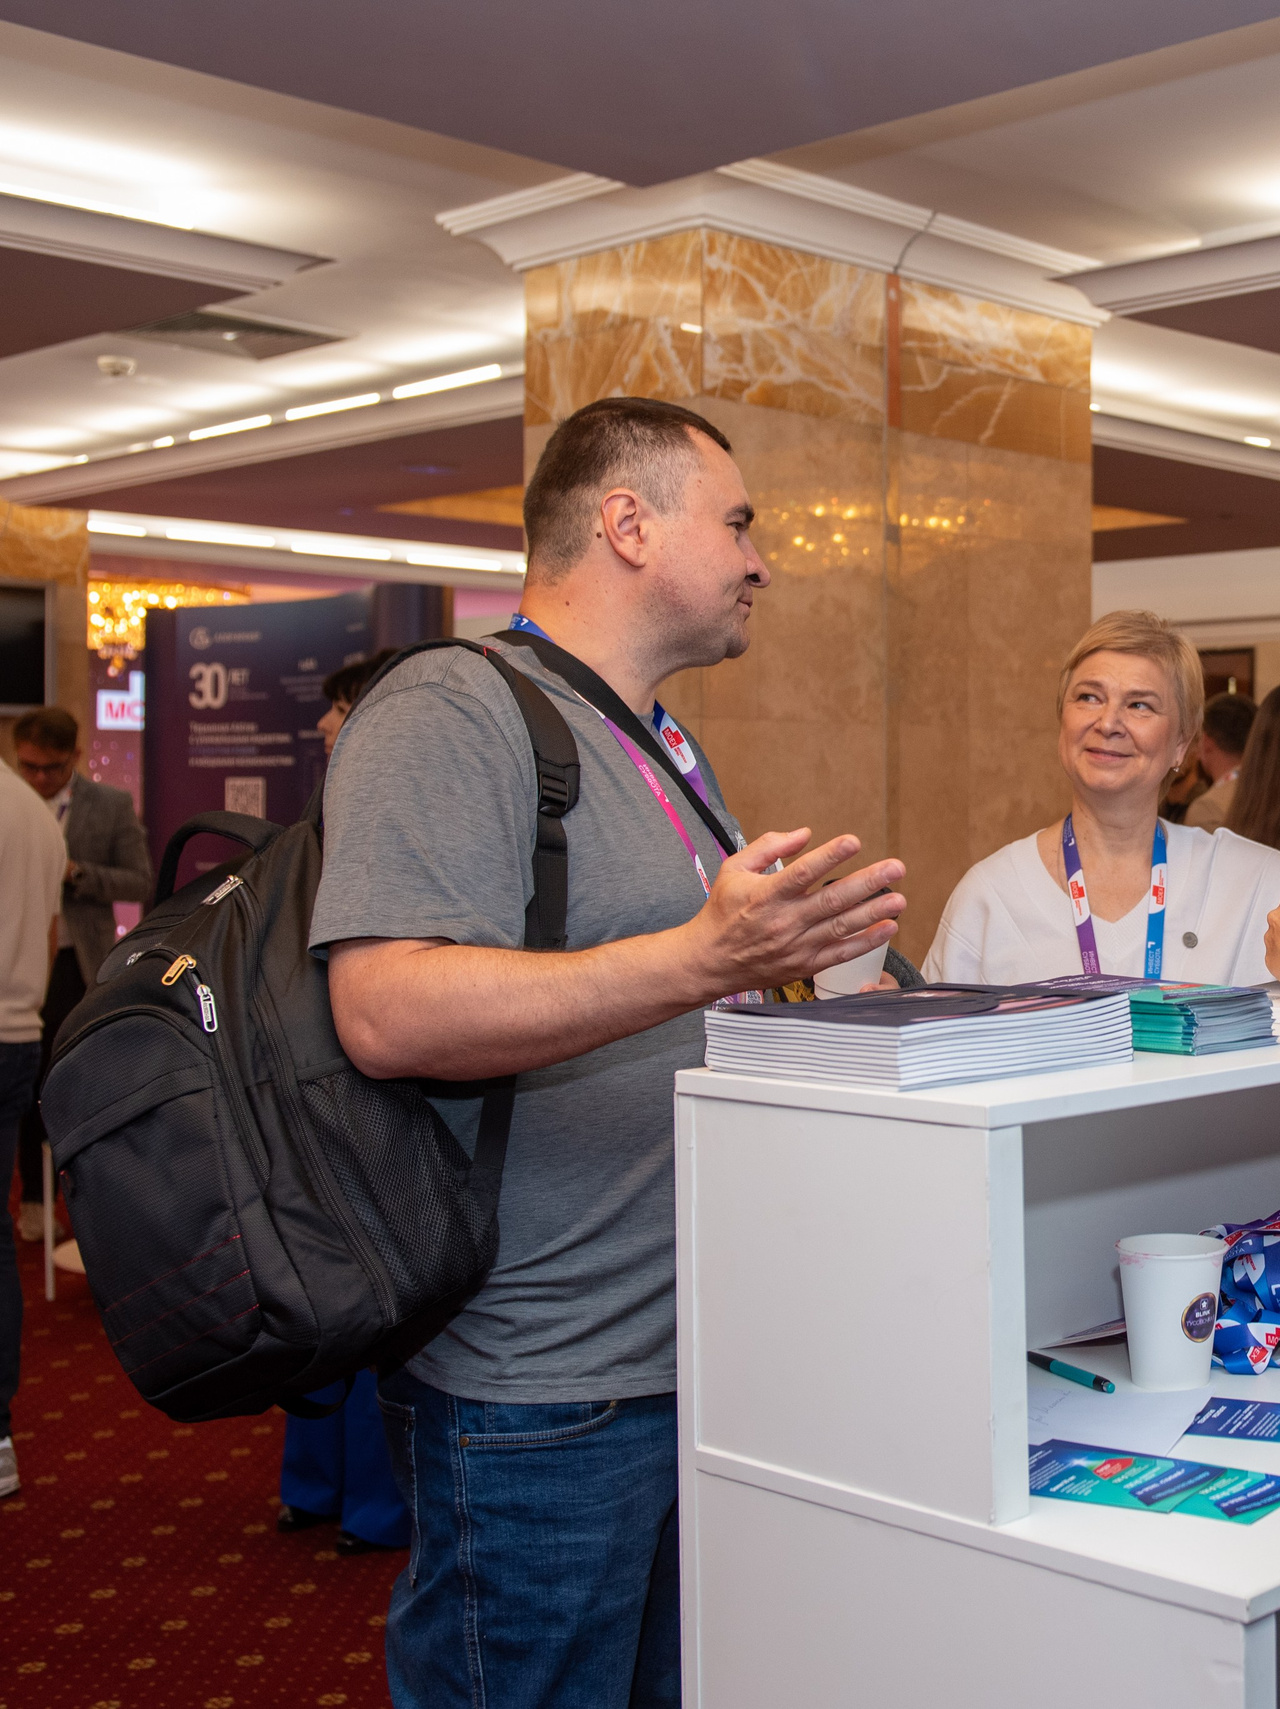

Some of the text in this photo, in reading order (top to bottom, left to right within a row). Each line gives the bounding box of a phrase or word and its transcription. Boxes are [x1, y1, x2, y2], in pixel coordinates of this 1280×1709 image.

[188, 661, 229, 710] 30
[664, 728, 677, 747] MOEX
[638, 764, 661, 796] СУББОТА
[1070, 881, 1078, 899] MOEX
[1089, 951, 1098, 974] ИНВЕСТ
[1195, 1309, 1210, 1318] BLINK
